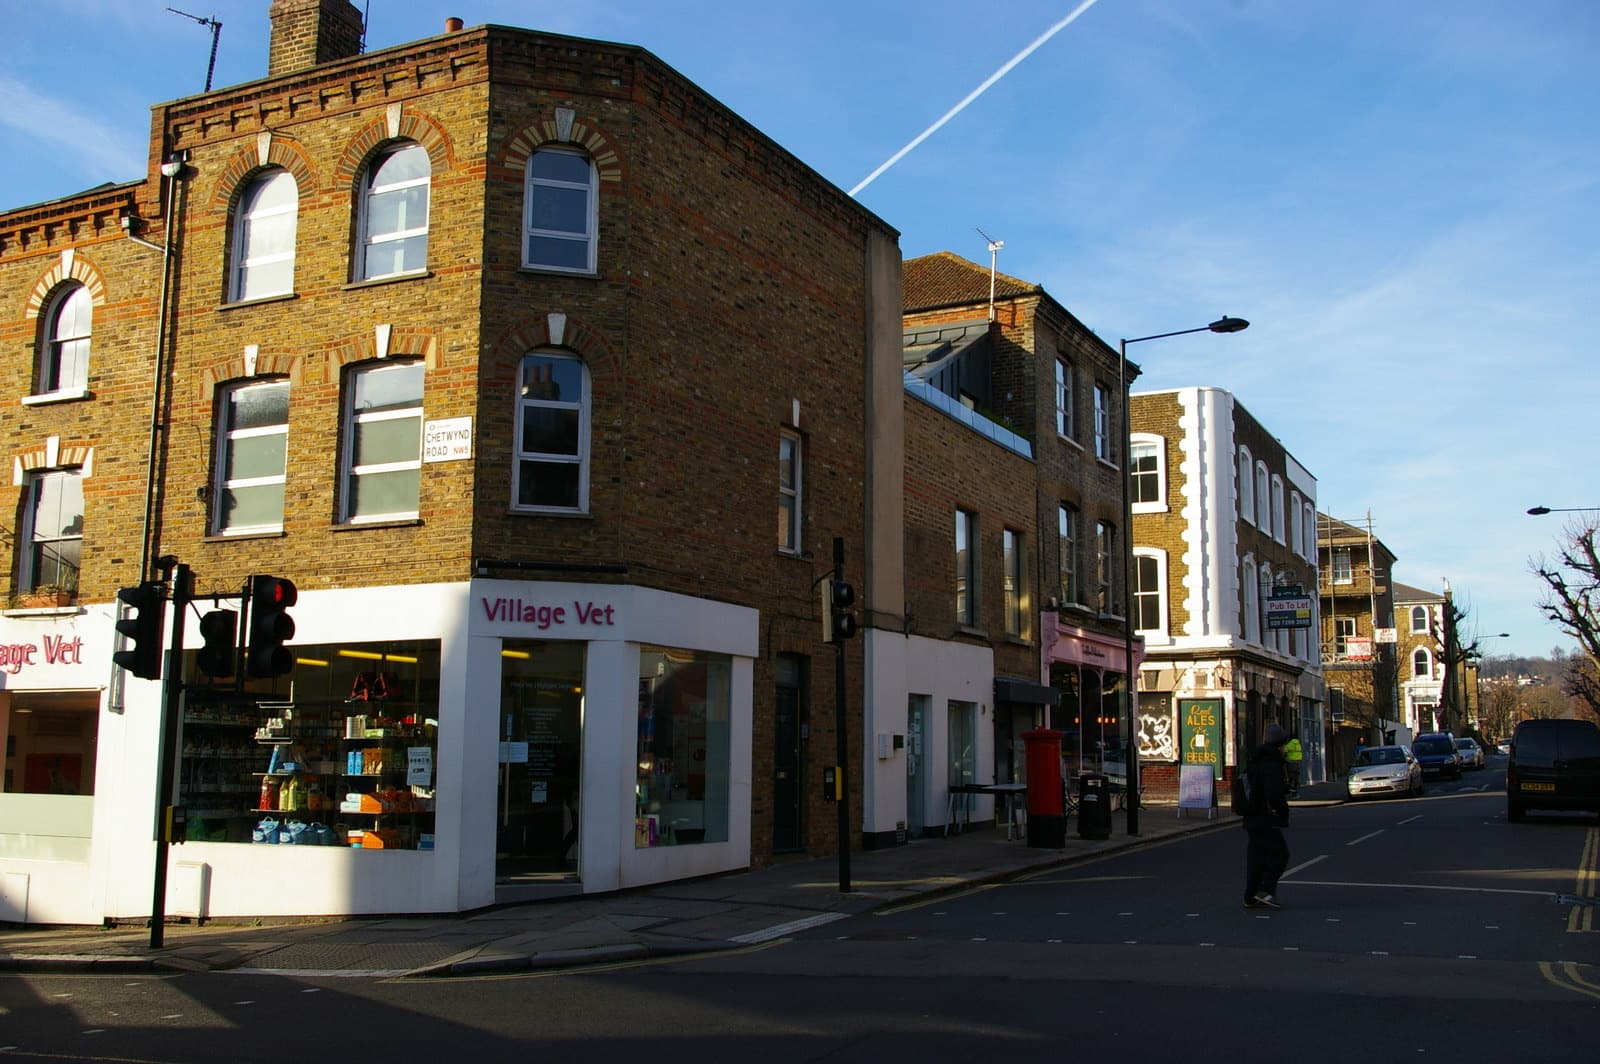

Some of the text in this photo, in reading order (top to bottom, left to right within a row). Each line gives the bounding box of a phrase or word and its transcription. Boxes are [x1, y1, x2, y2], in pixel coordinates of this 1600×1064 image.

[426, 429, 470, 443] CHETWYND
[426, 446, 469, 457] ROAD NW5
[1269, 601, 1309, 610] Pub To Let
[482, 597, 615, 630] Village Vet
[42, 634, 84, 665] Vet
[1190, 704, 1213, 715] Real
[1187, 715, 1215, 726] ALES
[1186, 752, 1217, 763] BEERS
